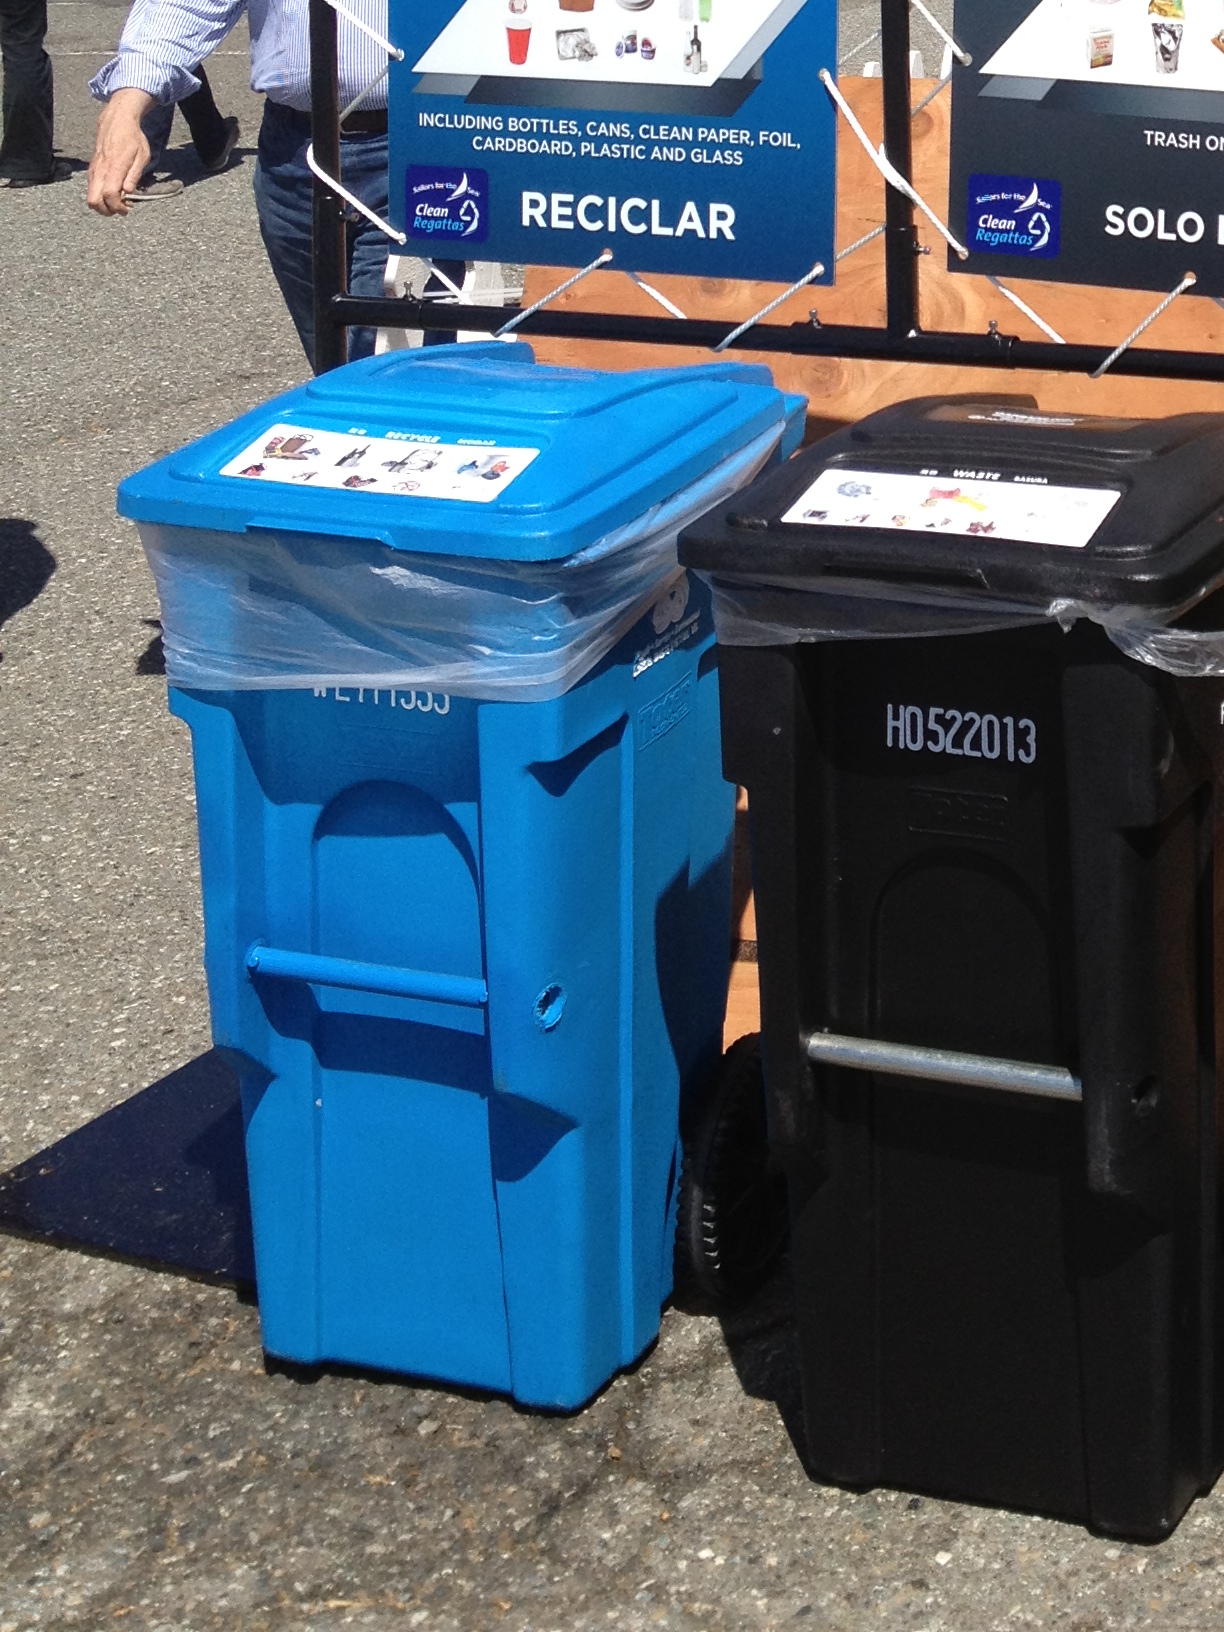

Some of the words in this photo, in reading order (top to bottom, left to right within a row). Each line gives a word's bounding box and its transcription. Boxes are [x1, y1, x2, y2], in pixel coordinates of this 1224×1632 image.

[418, 112, 504, 131] INCLUDING
[508, 117, 582, 138] BOTTLES,
[586, 121, 635, 141] CANS,
[638, 124, 693, 142] CLEAN
[698, 127, 755, 148] PAPER,
[758, 131, 801, 150] FOIL,
[1143, 129, 1200, 150] TRASH
[472, 136, 577, 158] CARDBOARD,
[580, 142, 646, 160] PLASTIC
[650, 145, 686, 162] AND
[690, 148, 743, 166] GLASS
[415, 203, 449, 218] Clean
[521, 190, 736, 241] RECICLAR
[413, 216, 465, 234] Regattas
[978, 214, 1016, 230] Clean
[1103, 204, 1202, 244] SOLO
[975, 228, 1034, 246] Regattas
[952, 469, 1001, 481] WASTE
